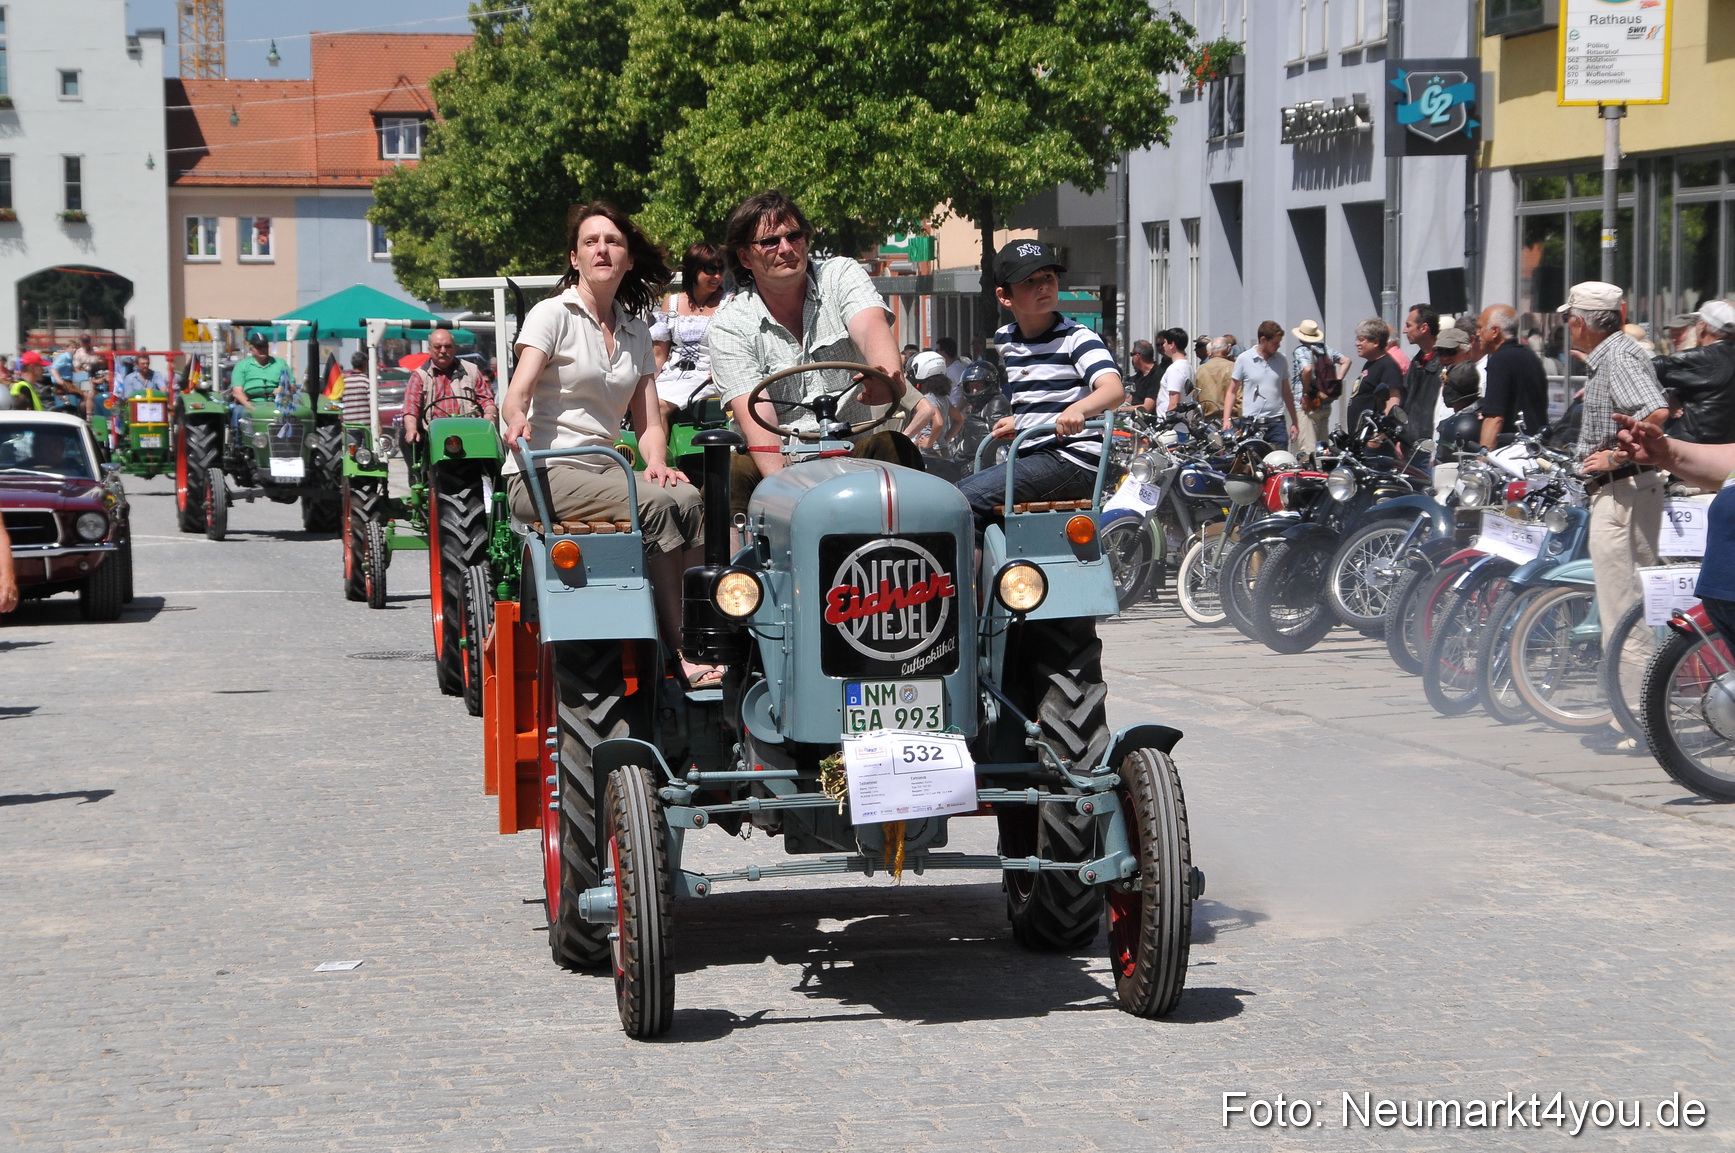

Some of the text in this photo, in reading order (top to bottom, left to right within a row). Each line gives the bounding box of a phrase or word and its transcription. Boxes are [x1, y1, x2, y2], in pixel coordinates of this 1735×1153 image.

[1589, 14, 1642, 25] Rathaus
[1420, 84, 1453, 125] G2
[1016, 243, 1041, 257] NY
[1139, 488, 1153, 501] 556
[1667, 511, 1692, 523] 129
[824, 572, 956, 625] Eicher
[850, 696, 858, 705] D
[865, 683, 897, 706] NM
[851, 705, 940, 731] GA 993
[903, 745, 944, 763] 532
